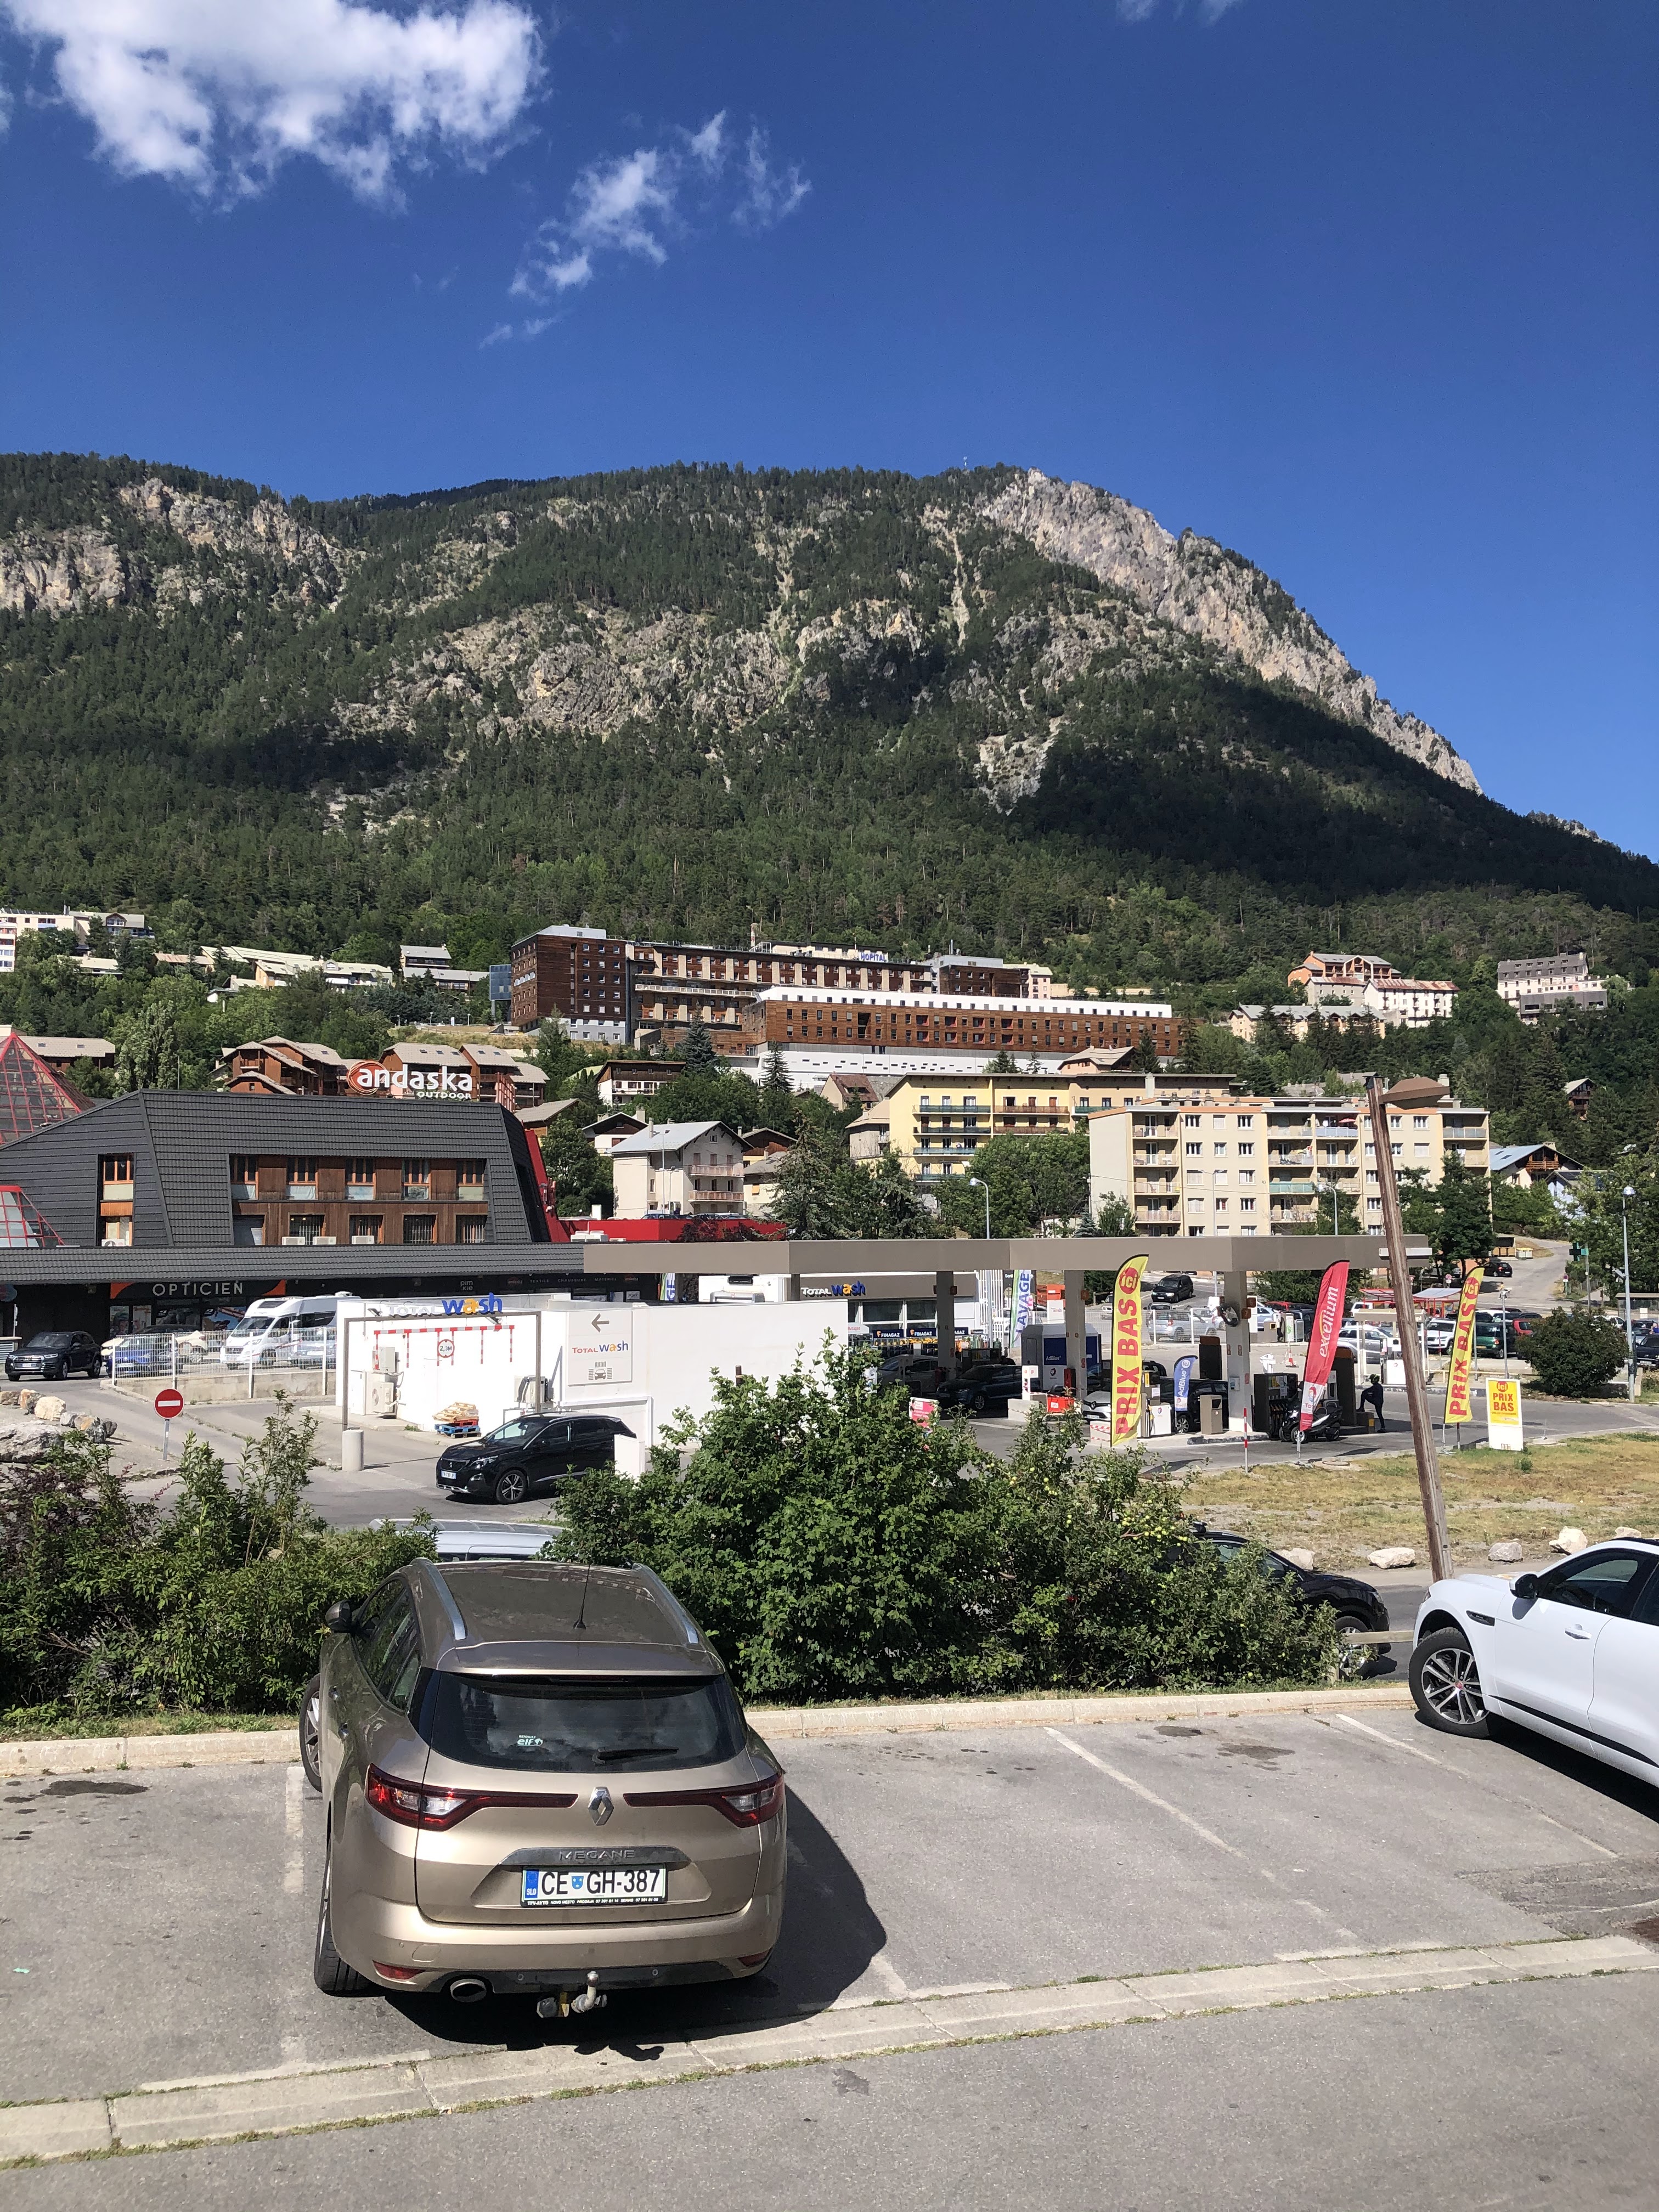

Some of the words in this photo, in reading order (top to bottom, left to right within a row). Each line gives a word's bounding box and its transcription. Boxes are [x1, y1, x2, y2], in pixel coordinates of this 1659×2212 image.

[357, 1064, 472, 1092] andaska
[152, 1282, 243, 1296] OPTICIEN
[801, 1287, 832, 1296] TOTAL
[831, 1280, 866, 1296] wash
[1121, 1274, 1137, 1289] ici
[1464, 1282, 1479, 1297] ici
[386, 1305, 441, 1316] TOTAL
[442, 1293, 503, 1315] wash
[1015, 1273, 1029, 1333] LAVAGE
[1118, 1299, 1139, 1357] BAS
[1319, 1286, 1339, 1358] excellium
[1457, 1303, 1476, 1351] BAS
[599, 1340, 628, 1352] wash
[1449, 1357, 1468, 1416] PRIX
[1493, 1392, 1514, 1401] PRIX
[1115, 1366, 1139, 1434] PRIX
[1493, 1402, 1514, 1412] BAS
[559, 1850, 635, 1861] MEGANE
[541, 1870, 569, 1895] CE
[586, 1869, 660, 1893] GH-387
